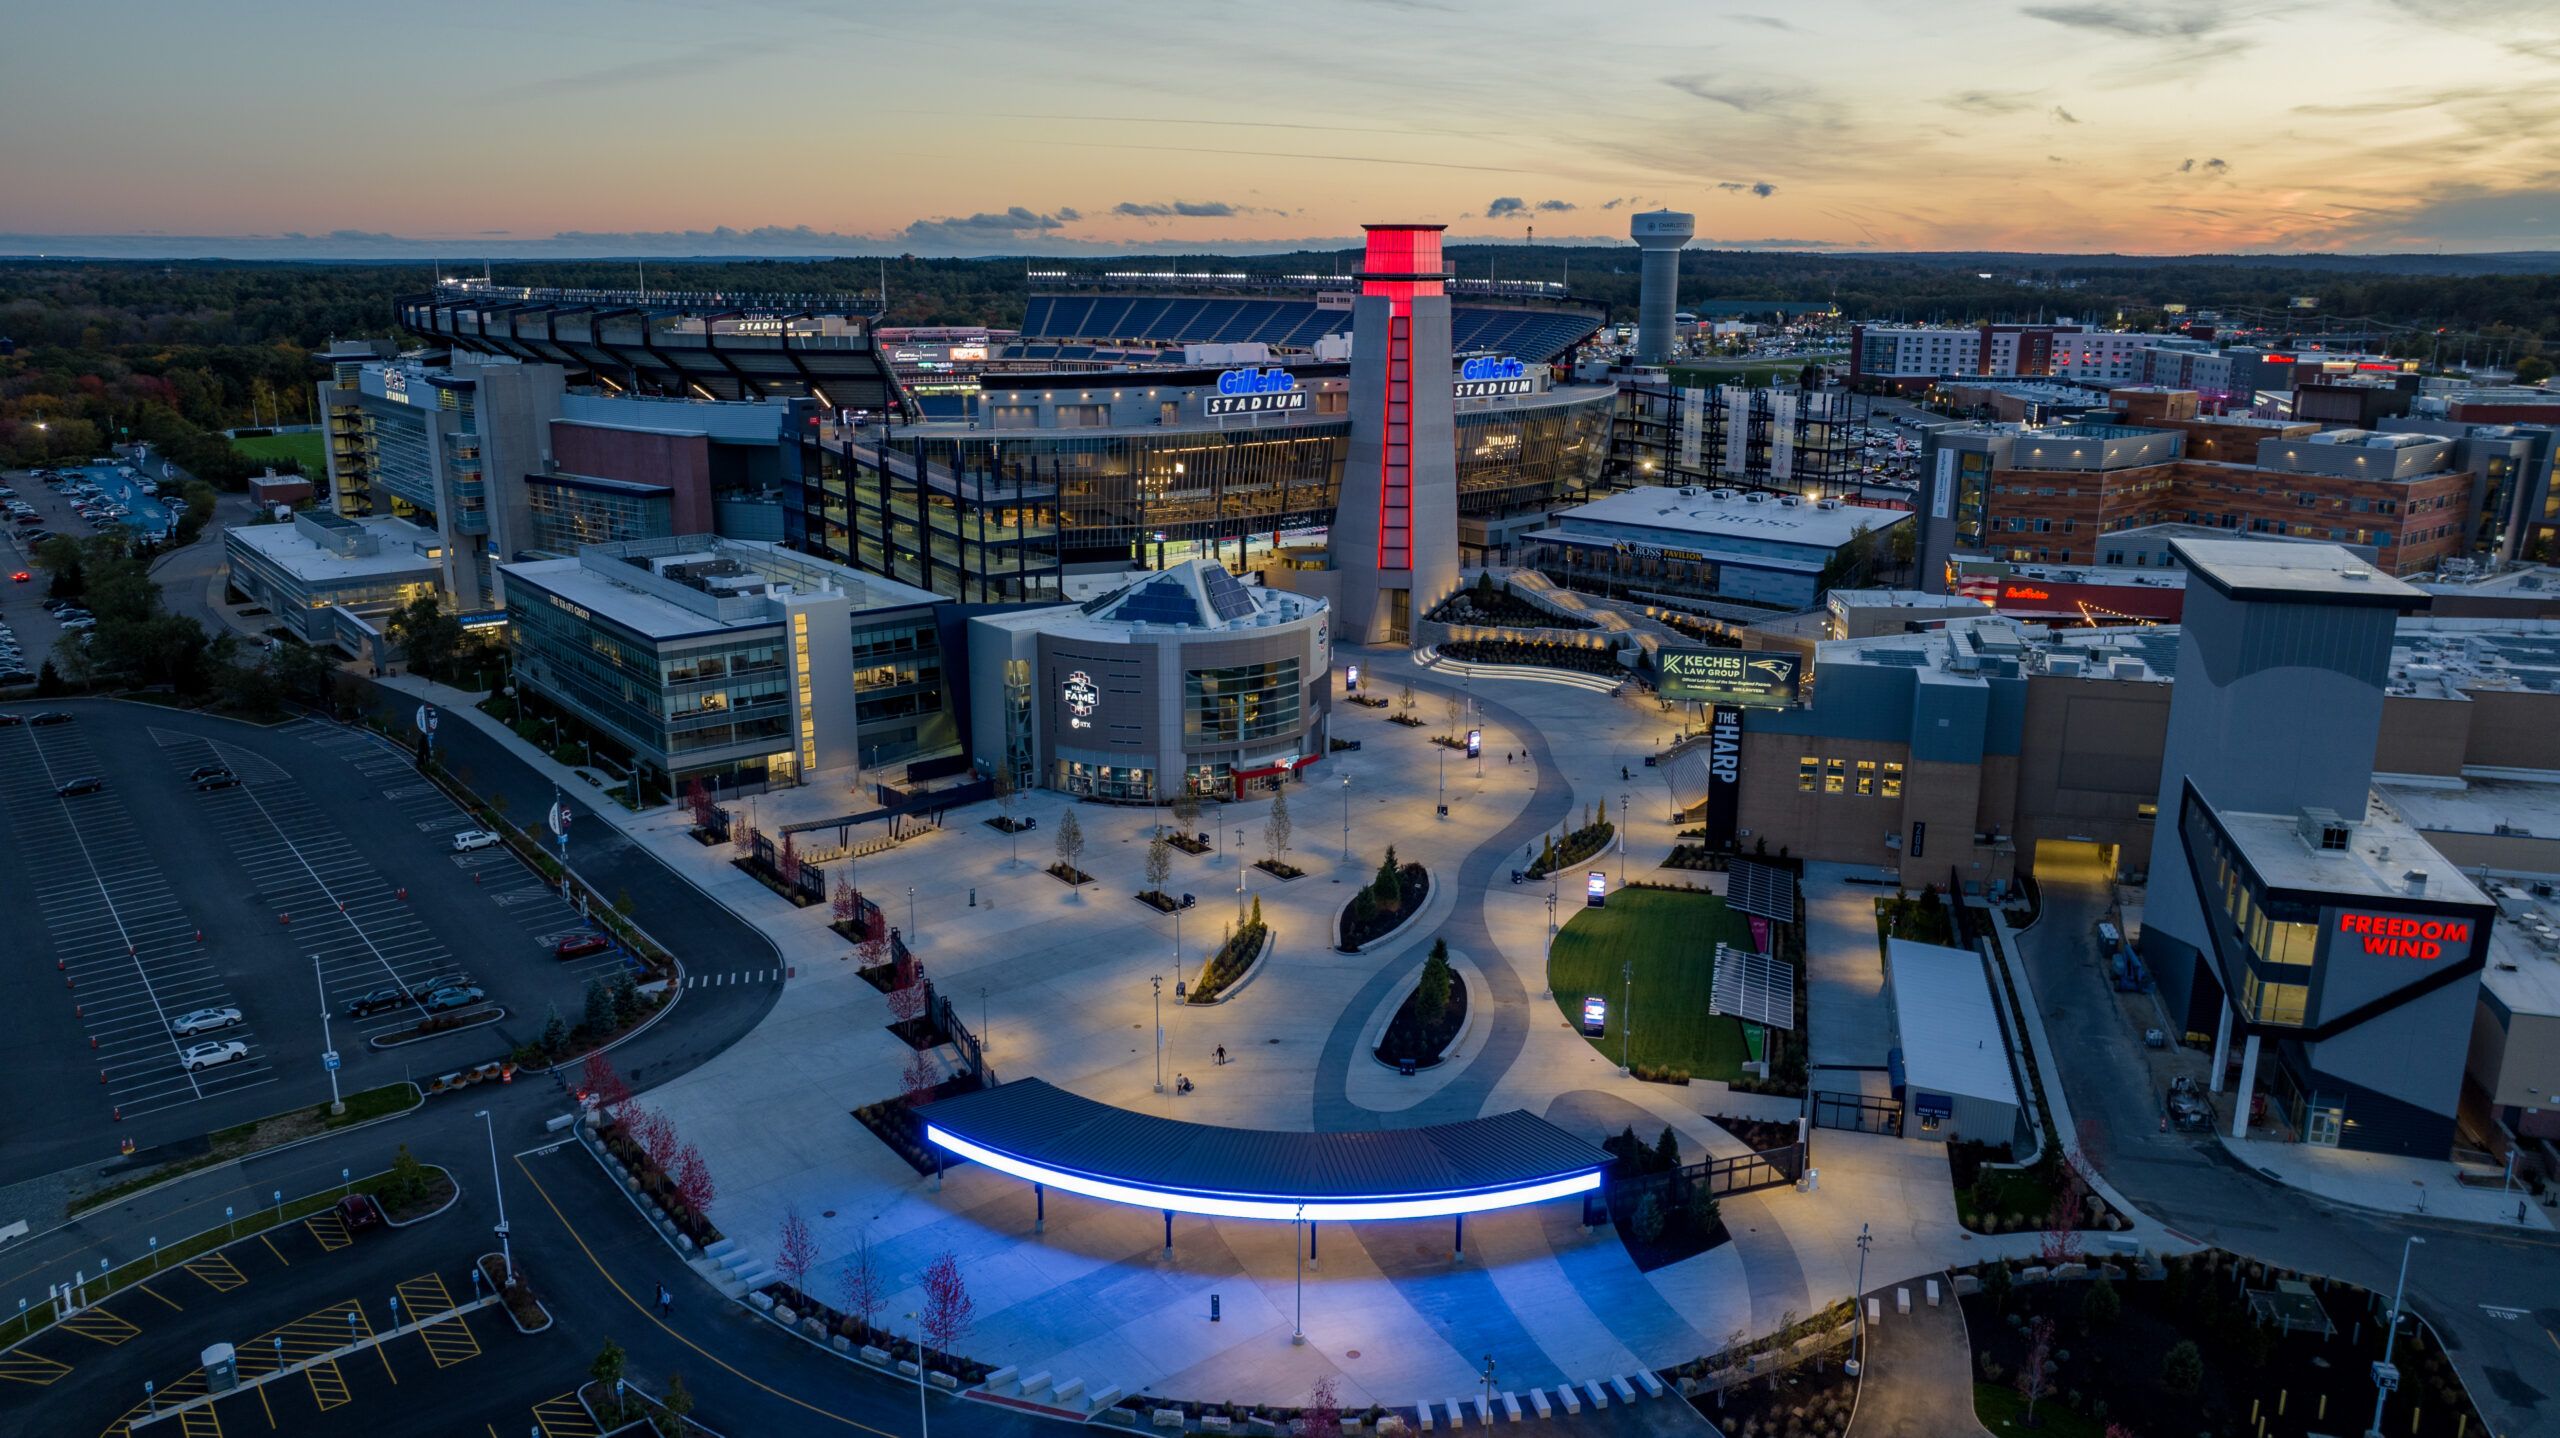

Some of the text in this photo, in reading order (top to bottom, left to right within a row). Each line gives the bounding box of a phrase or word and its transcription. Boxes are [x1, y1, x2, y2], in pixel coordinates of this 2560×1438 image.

[1461, 356, 1524, 381] Gillette
[1217, 368, 1295, 396] Gillette
[1455, 380, 1531, 397] STADIUM
[1210, 394, 1303, 413] STADIUM
[1626, 541, 1662, 557] CROSS
[1663, 549, 1702, 561] PAVILION
[549, 594, 590, 621] THE KRAFT GROUP
[1684, 655, 1741, 669] KECHES
[1684, 667, 1741, 678] LAW GROUP
[1065, 689, 1096, 704] FAME
[1071, 685, 1088, 693] HALL
[1717, 711, 1738, 724] THE
[1712, 726, 1740, 783] HARP
[2340, 913, 2468, 943] FREEDOM
[2363, 936, 2441, 960] WIND
[2486, 1308, 2519, 1321] STOP
